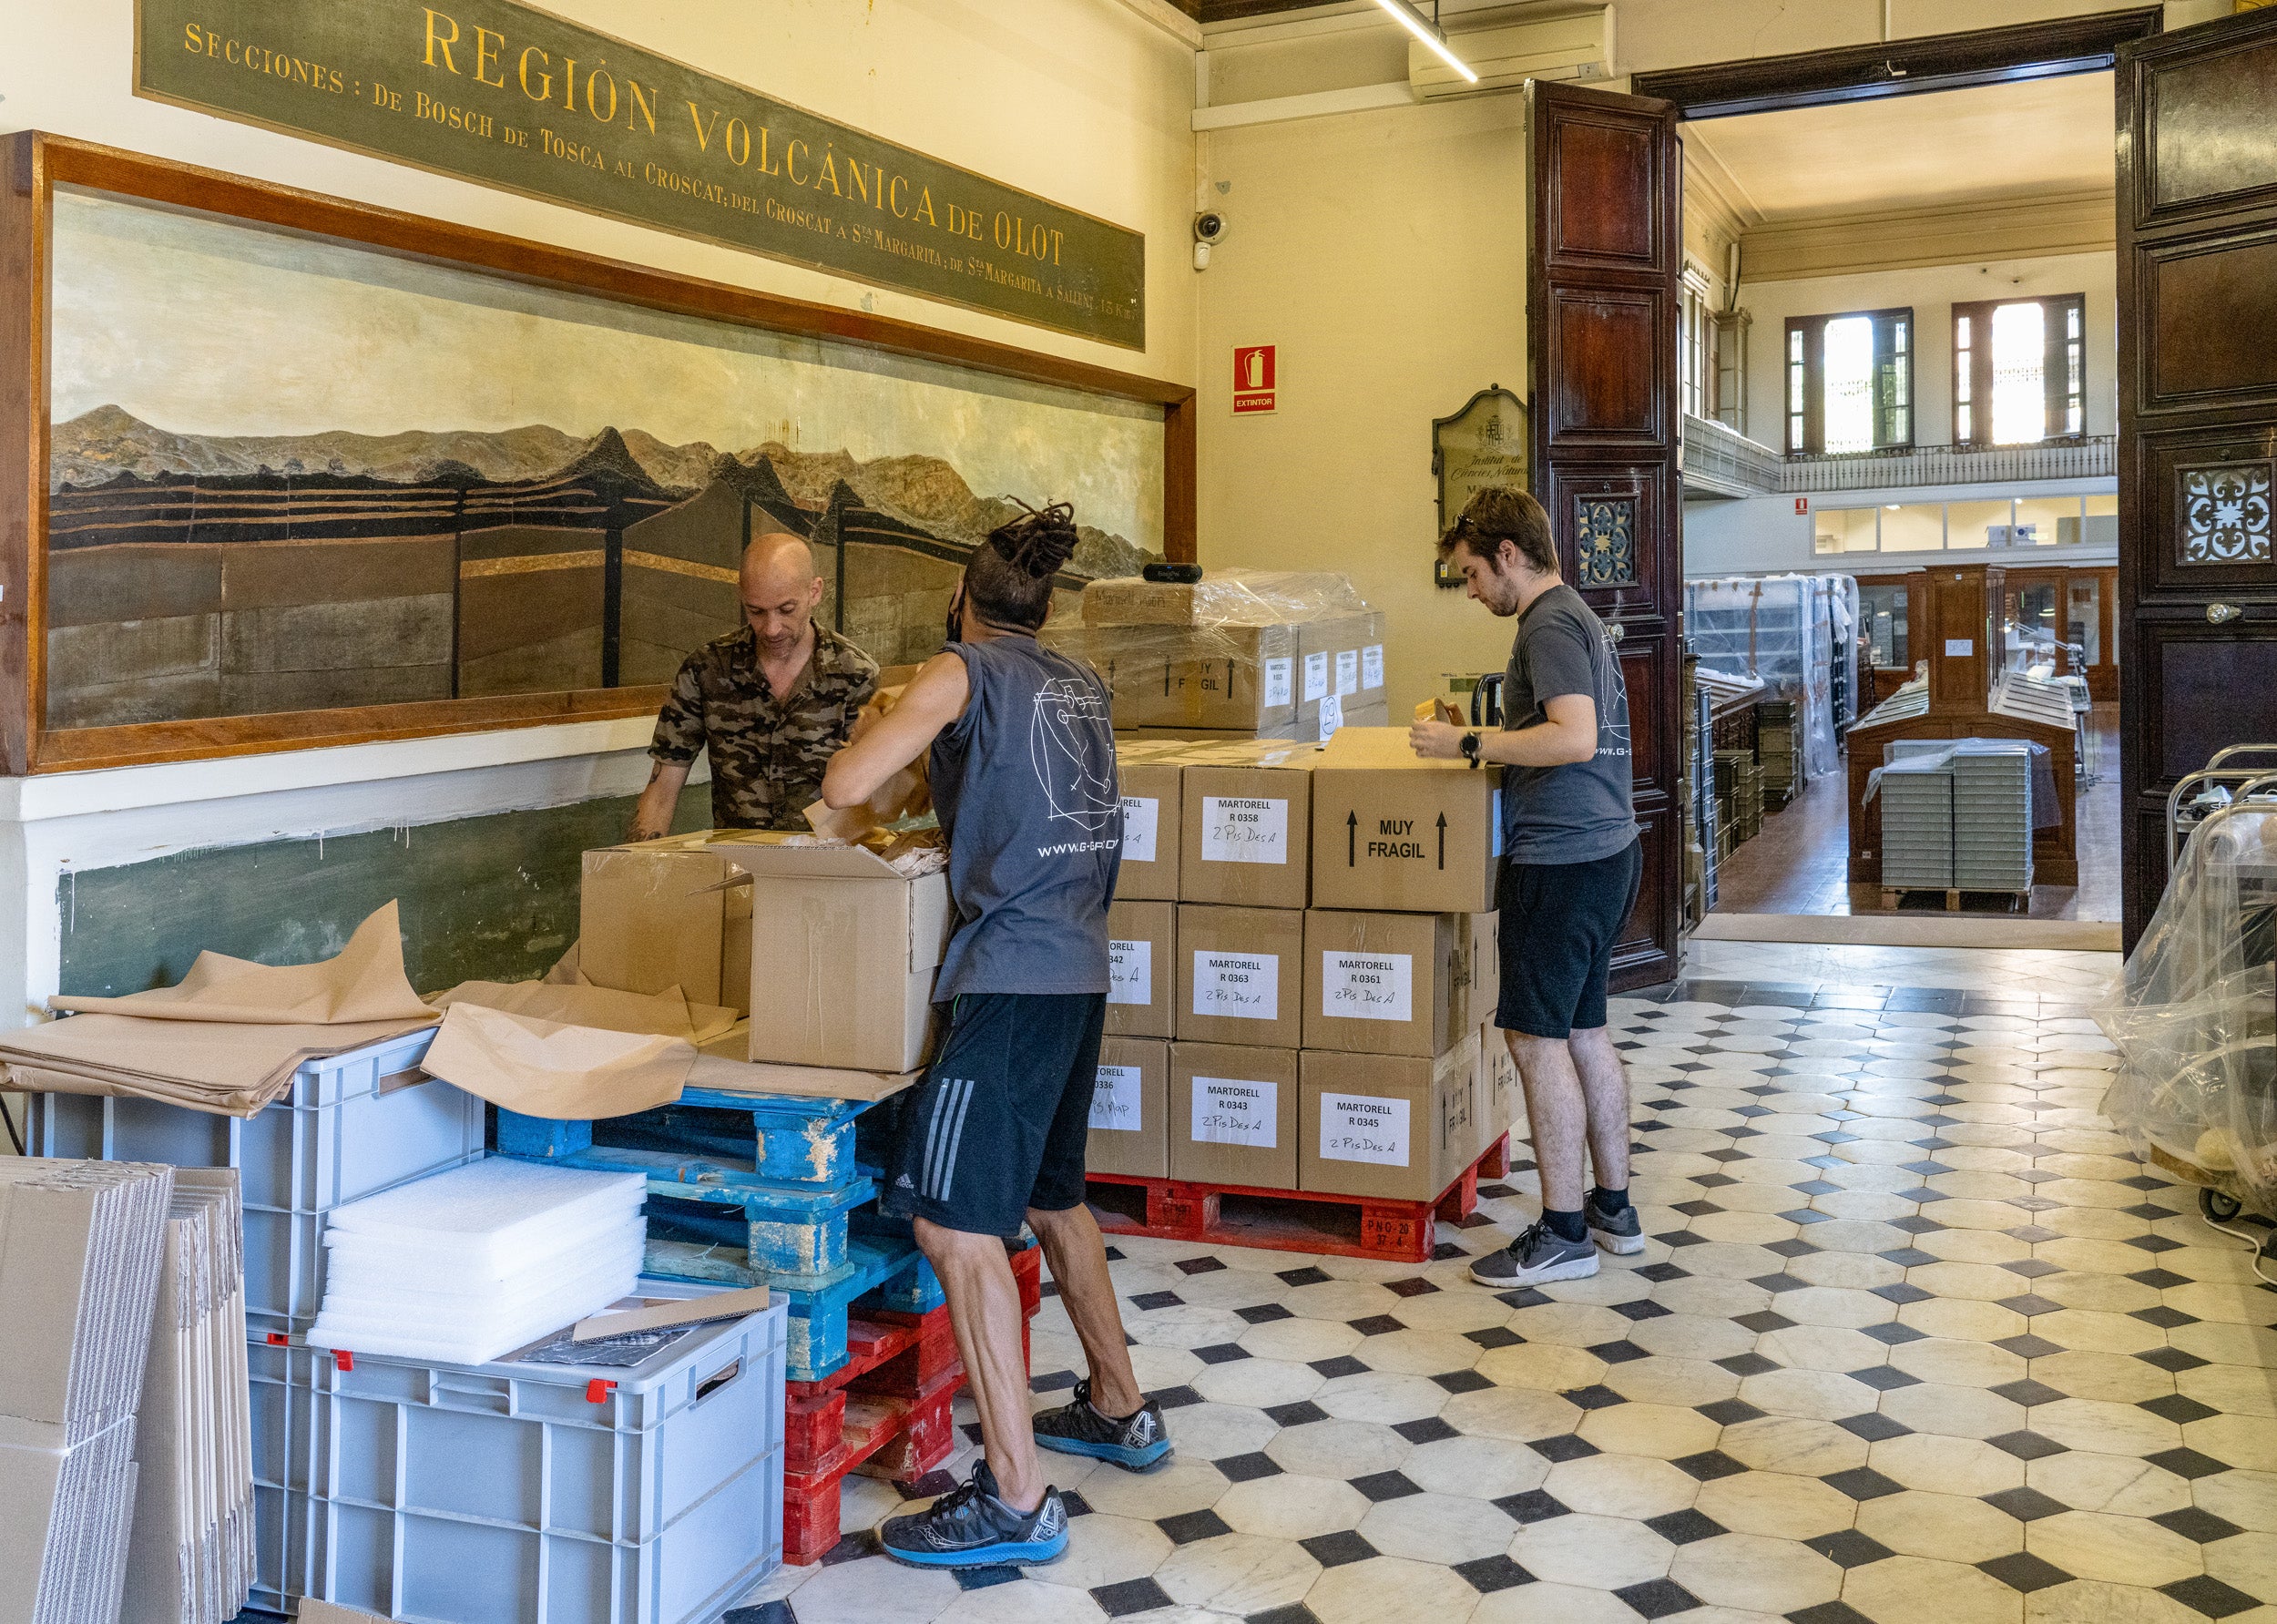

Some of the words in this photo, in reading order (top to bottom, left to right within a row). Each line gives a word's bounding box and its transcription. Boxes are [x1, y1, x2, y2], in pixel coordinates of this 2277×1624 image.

[422, 6, 658, 137] REGIÓN
[687, 100, 938, 228] VOLCÁNICA
[947, 203, 984, 242] DE
[995, 211, 1065, 267] OLOT
[373, 83, 402, 111] DE
[416, 91, 494, 138] BOSCH
[504, 127, 529, 148] DE
[540, 128, 607, 171] TOSCA
[614, 159, 637, 179] AL
[731, 192, 760, 216] DEL
[766, 198, 832, 233] CROSCAT
[836, 226, 847, 240] A
[950, 256, 964, 272] DE
[985, 262, 1042, 295] MARGARITA
[1046, 286, 1054, 299] A
[1236, 398, 1272, 408] EXTINTOR
[1510, 455, 1523, 464] de
[1490, 465, 1527, 478] Natura
[1179, 679, 1220, 690] FGIL
[1323, 701, 1335, 726] 29
[1218, 800, 1271, 810] MARTORELL
[1230, 813, 1235, 822] R
[1238, 813, 1259, 822] 0358
[1379, 820, 1414, 835] MUY
[1213, 826, 1221, 840] 2
[1268, 832, 1276, 843] A
[1368, 842, 1425, 858] FRAGIL
[1109, 942, 1135, 951] ORELL
[1109, 955, 1124, 964] 342
[1209, 959, 1261, 970] MARTORELL
[1339, 960, 1394, 971] MARTORELL
[1129, 967, 1138, 983] A
[1220, 974, 1226, 982] R
[1228, 974, 1249, 983] 0363
[1352, 975, 1357, 983] R
[1359, 975, 1381, 984] 0361
[1206, 990, 1213, 1000] 2
[1252, 995, 1261, 1004] A
[1383, 991, 1394, 1004] A
[1096, 1067, 1124, 1077] TORELL
[1208, 1086, 1260, 1098] MARTORELL
[1219, 1100, 1224, 1108] R
[1227, 1100, 1248, 1110] 0343
[1337, 1102, 1392, 1115] MARTORELL
[1202, 1116, 1212, 1127] 2
[1252, 1120, 1261, 1130] A
[1349, 1117, 1354, 1126] R
[1357, 1118, 1379, 1128] 0345
[1331, 1139, 1338, 1148] 2
[1388, 1141, 1396, 1152] A
